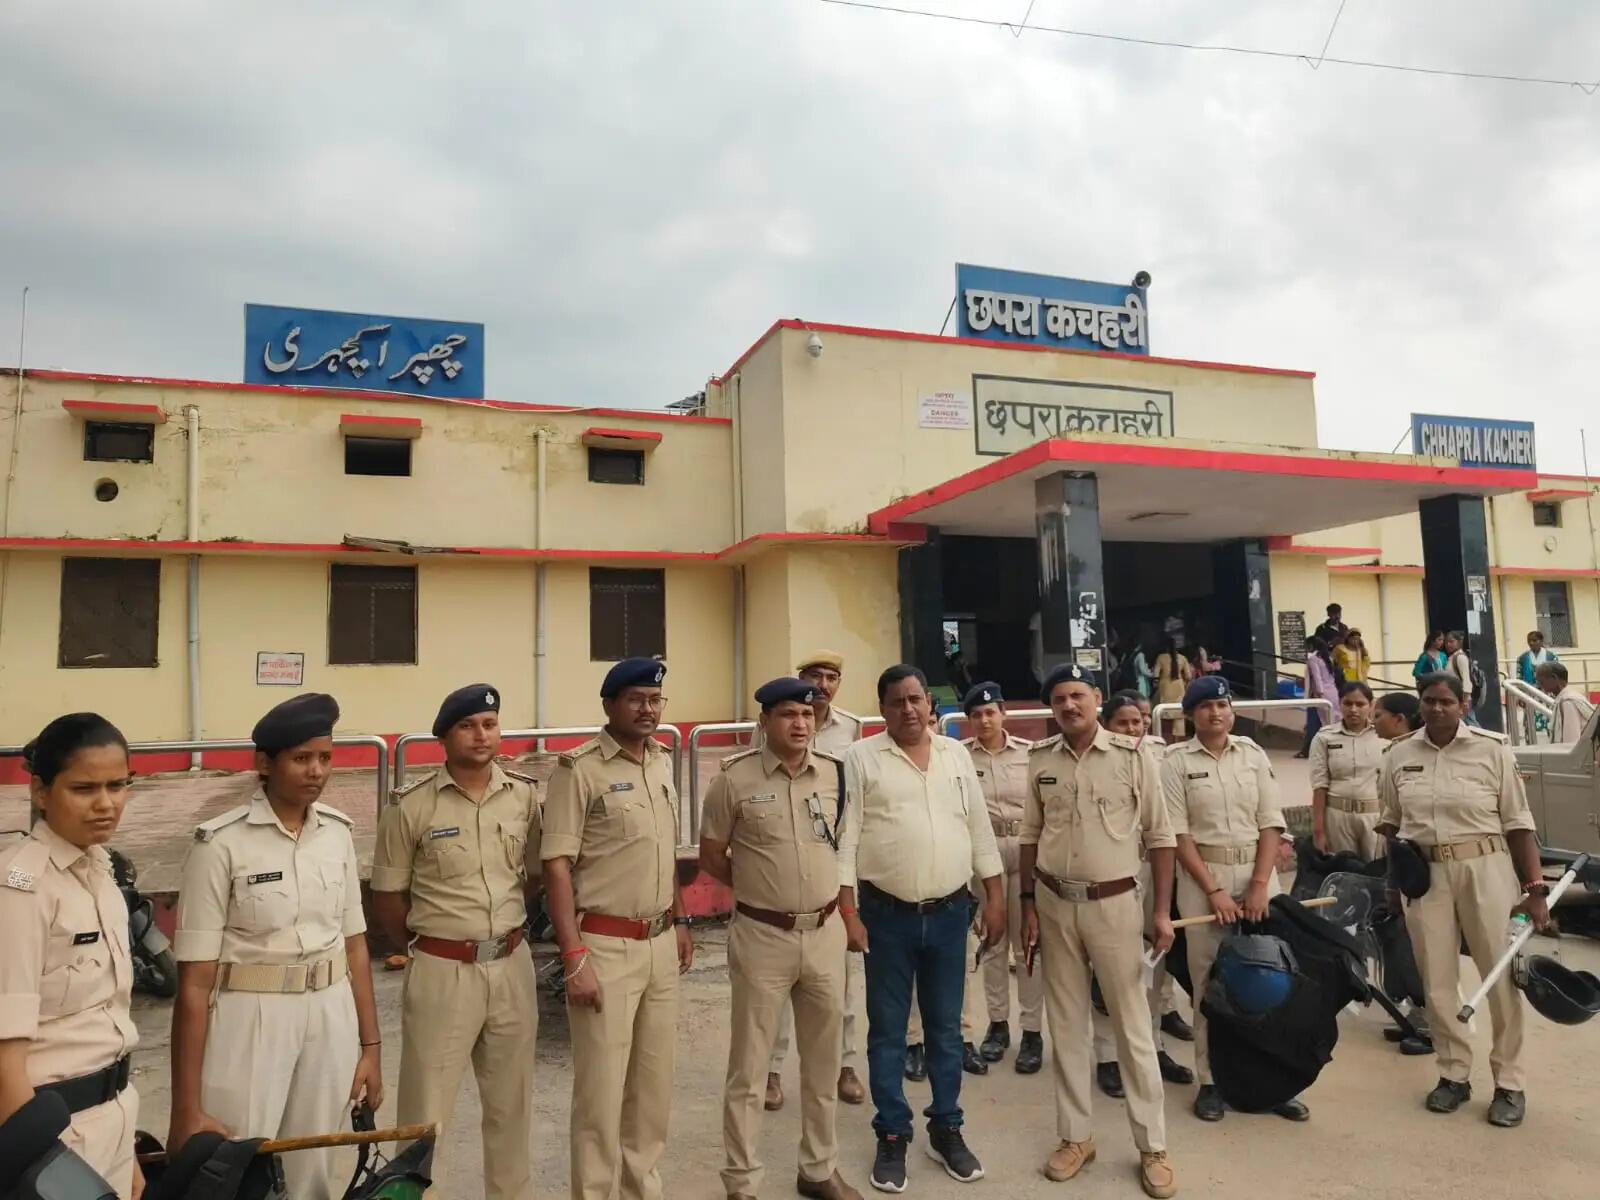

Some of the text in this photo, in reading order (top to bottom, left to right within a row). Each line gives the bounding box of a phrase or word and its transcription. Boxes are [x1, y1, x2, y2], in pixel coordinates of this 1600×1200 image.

[965, 289, 1146, 348] छपरा कचहरी
[985, 400, 1061, 438] छपरा
[1421, 422, 1536, 464] CHHAPRA KACHERI
